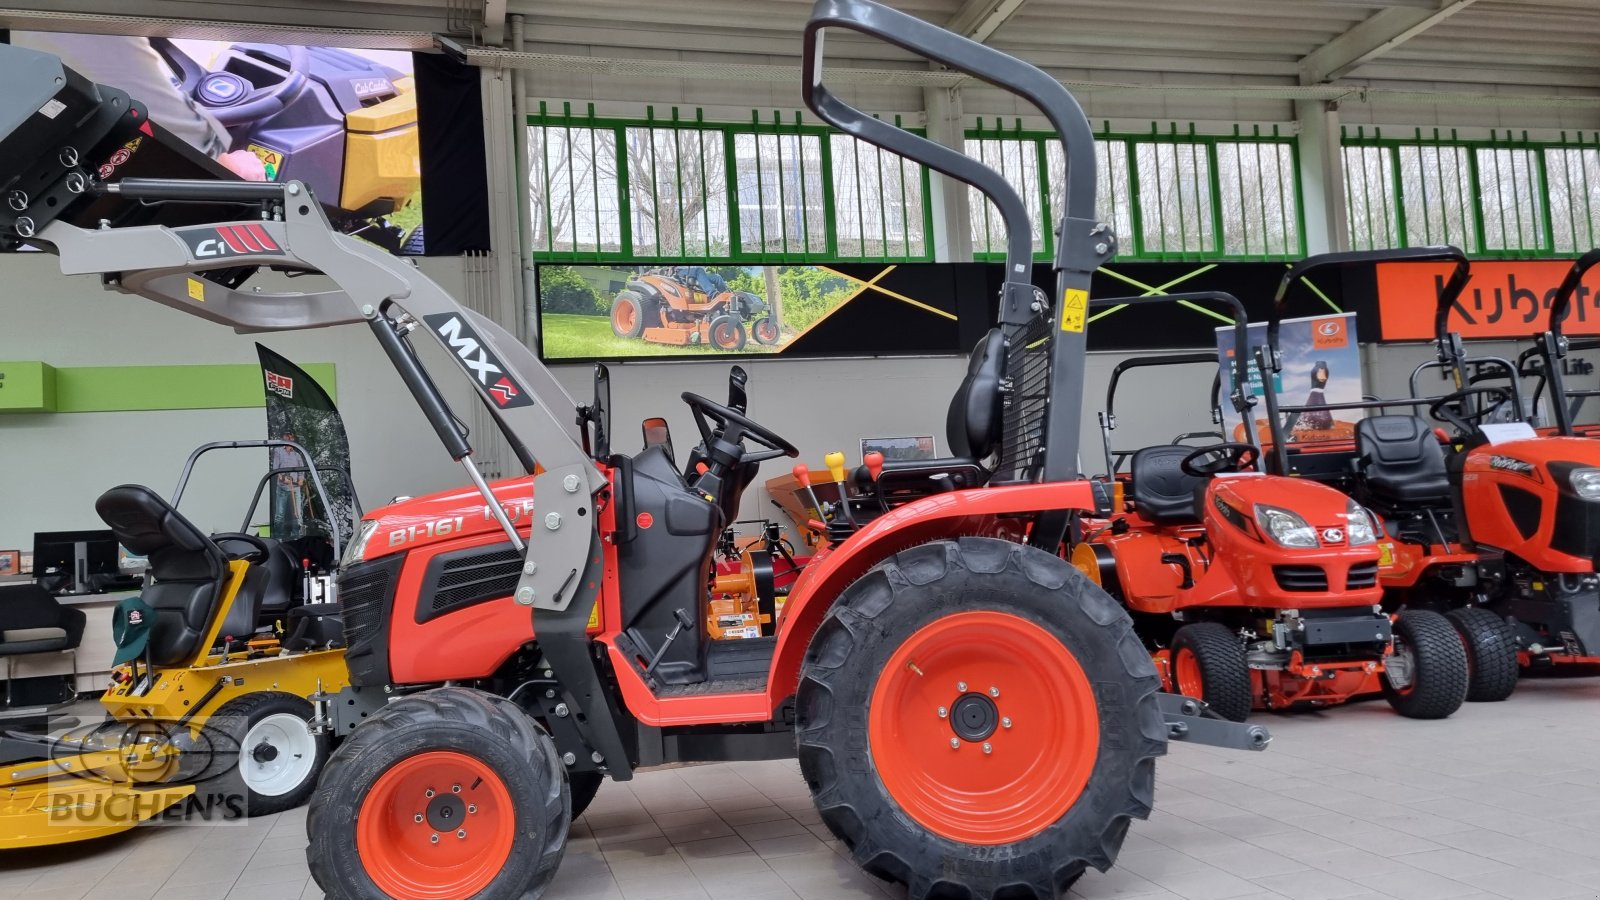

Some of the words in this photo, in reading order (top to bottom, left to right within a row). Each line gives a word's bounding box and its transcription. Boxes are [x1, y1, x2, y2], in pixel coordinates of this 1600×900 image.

[195, 238, 226, 257] C1
[438, 317, 503, 386] MX
[1562, 358, 1594, 376] Life
[388, 516, 464, 547] B1-161
